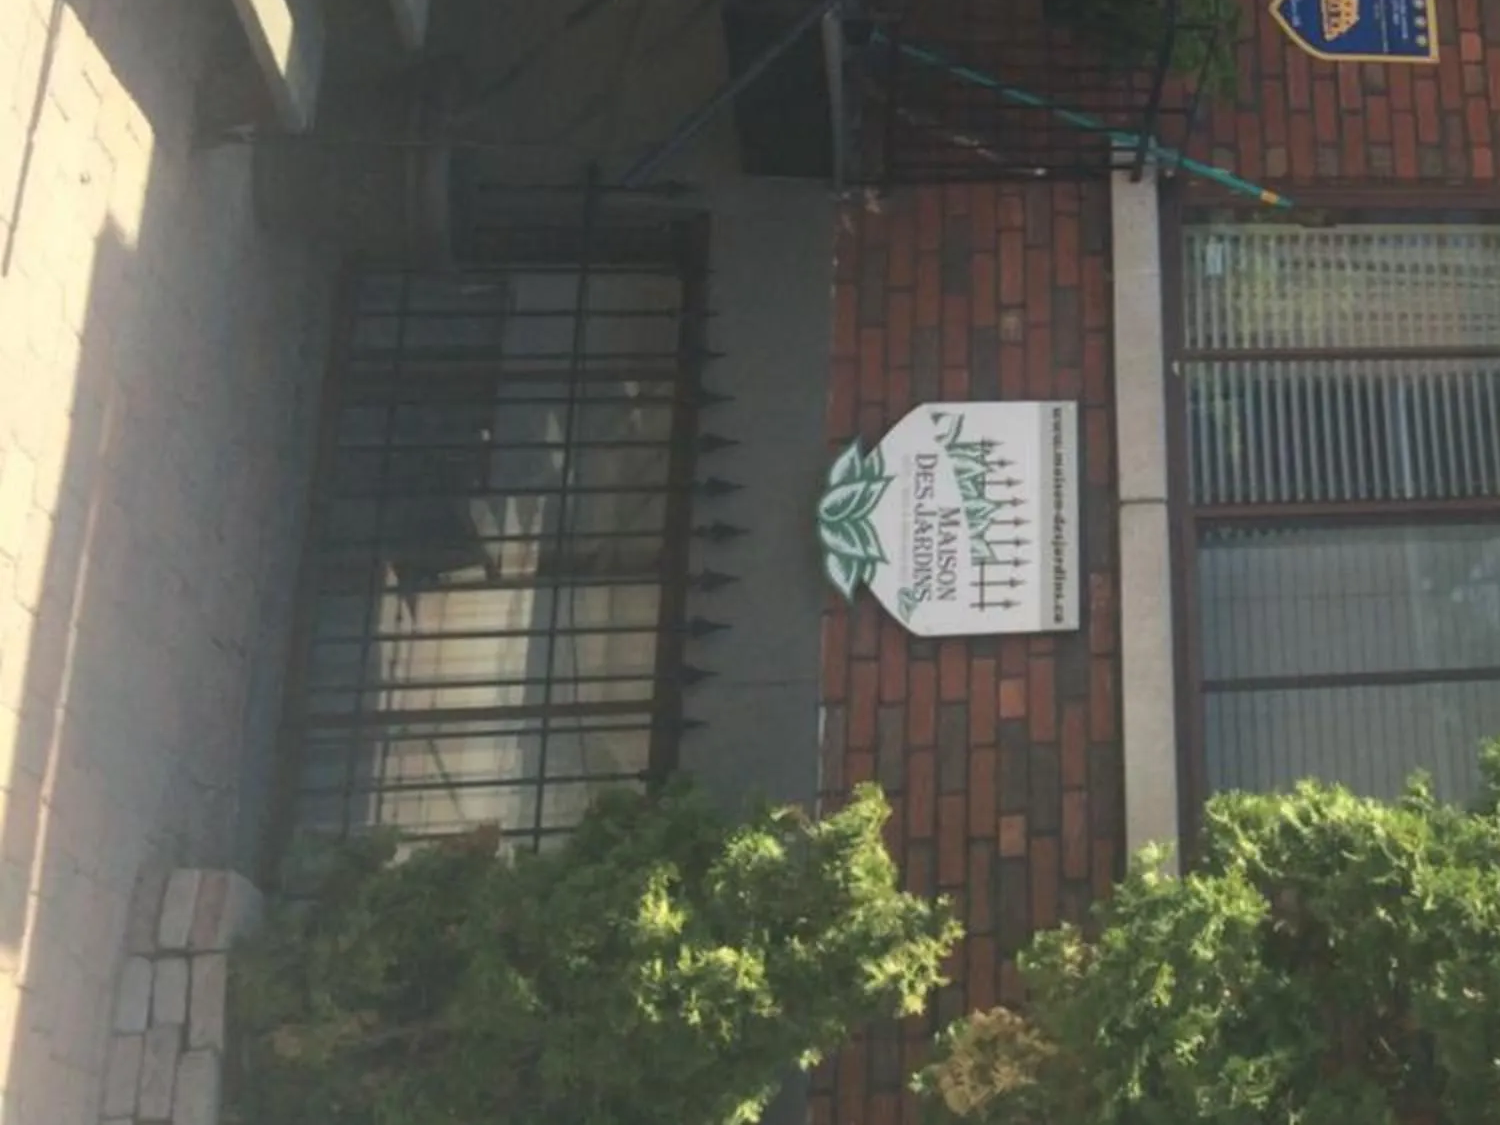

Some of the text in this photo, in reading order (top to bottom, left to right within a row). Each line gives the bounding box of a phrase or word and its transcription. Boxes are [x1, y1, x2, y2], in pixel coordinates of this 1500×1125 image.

[913, 453, 938, 603] DES JARDINS
[937, 507, 961, 601] MAISON
